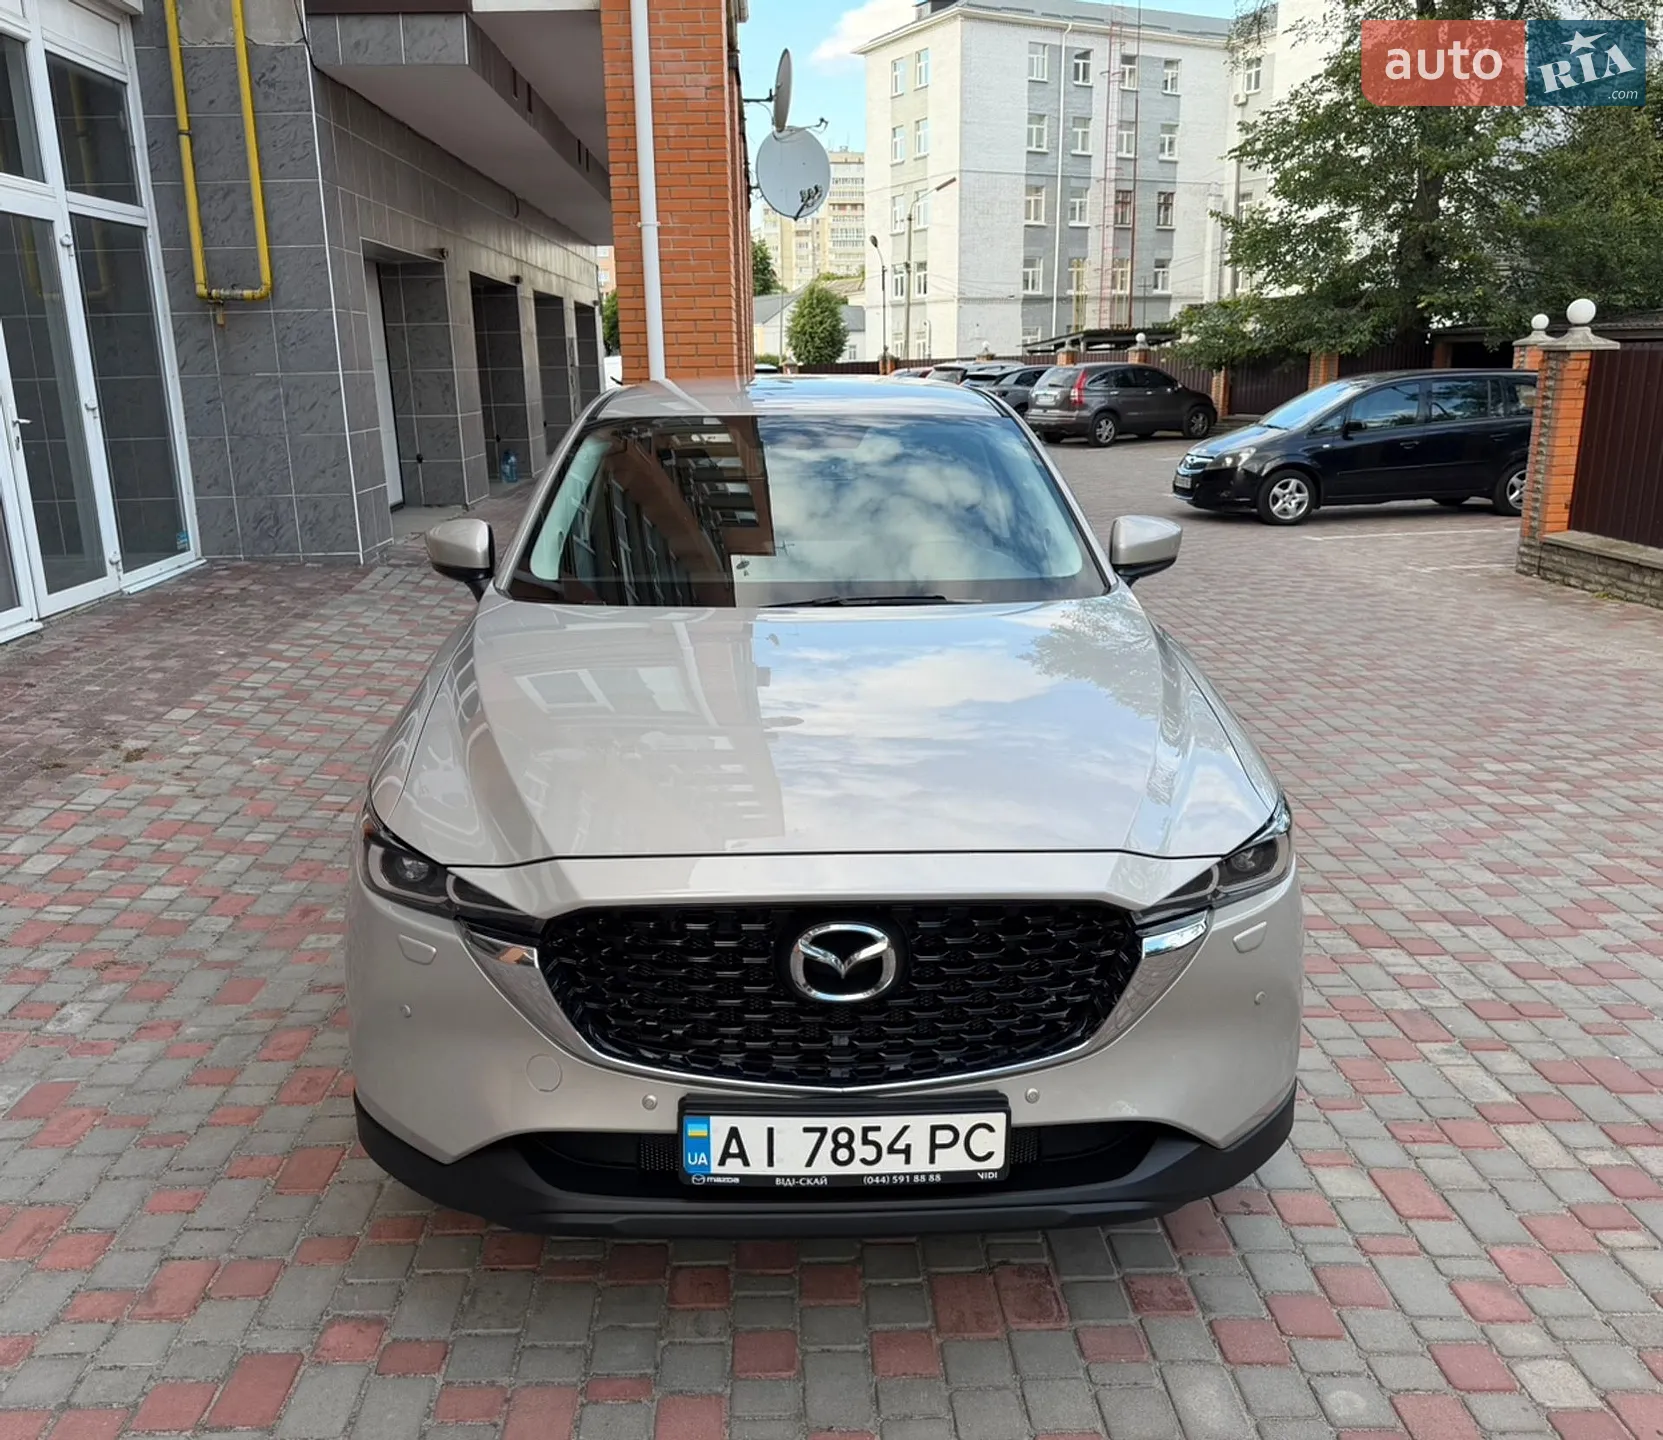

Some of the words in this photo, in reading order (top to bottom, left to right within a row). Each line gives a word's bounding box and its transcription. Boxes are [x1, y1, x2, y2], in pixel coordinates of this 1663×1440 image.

[717, 1126, 775, 1168] AI
[802, 1124, 911, 1168] 7854
[928, 1123, 996, 1165] PC
[687, 1152, 708, 1166] UA
[706, 1176, 740, 1184] mazda
[863, 1175, 890, 1185] (044)
[892, 1174, 910, 1184] 591
[913, 1174, 926, 1183] 88
[928, 1173, 941, 1182] 88
[977, 1171, 998, 1180] VIDI
